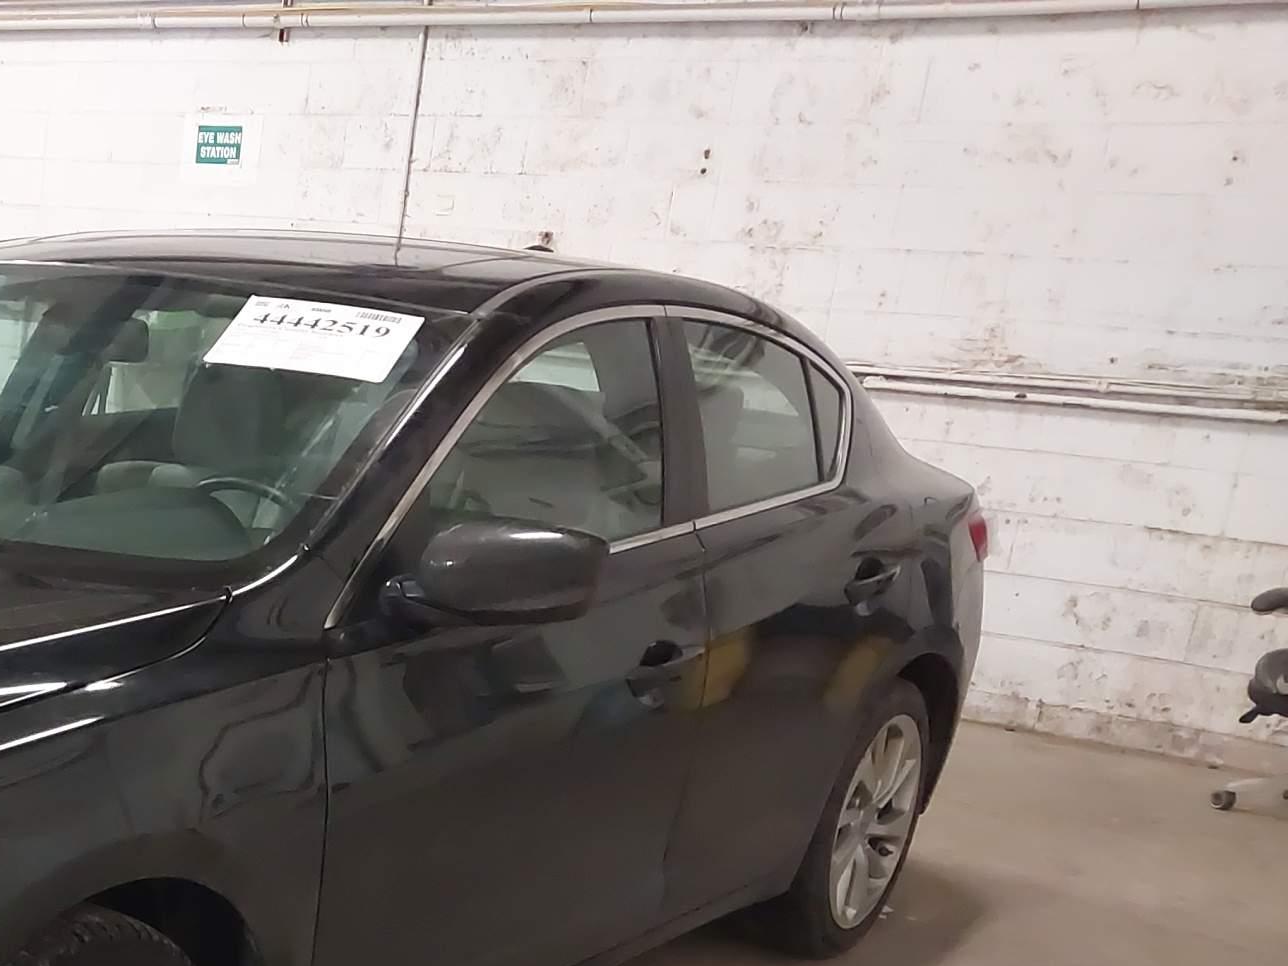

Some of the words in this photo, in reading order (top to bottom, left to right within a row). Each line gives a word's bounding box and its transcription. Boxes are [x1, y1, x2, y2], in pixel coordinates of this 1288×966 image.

[198, 131, 215, 144] EYE
[216, 131, 242, 144] WASH
[200, 146, 237, 159] STATION
[252, 312, 391, 338] 44442519
